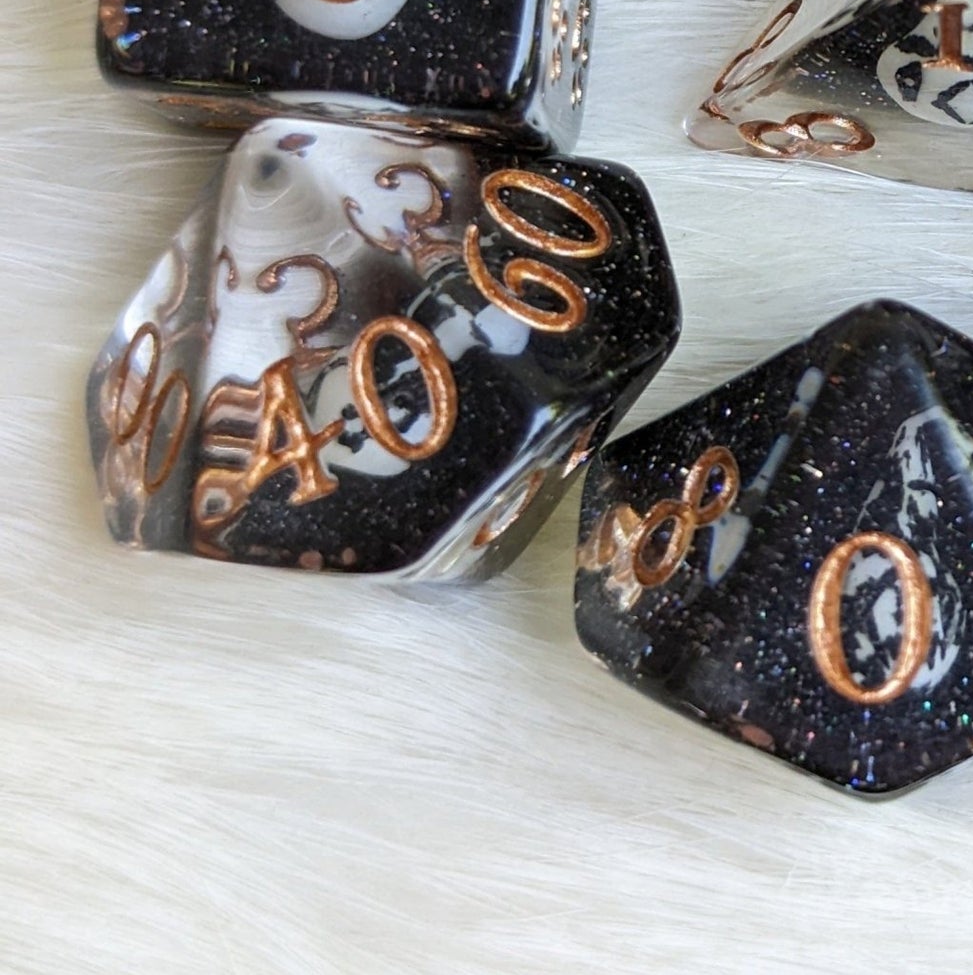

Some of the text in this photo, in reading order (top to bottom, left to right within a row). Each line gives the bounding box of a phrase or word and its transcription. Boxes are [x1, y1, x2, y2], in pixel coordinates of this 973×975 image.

[463, 169, 613, 333] 60
[240, 315, 457, 505] 40
[634, 444, 741, 589] 8
[809, 531, 933, 705] 0
